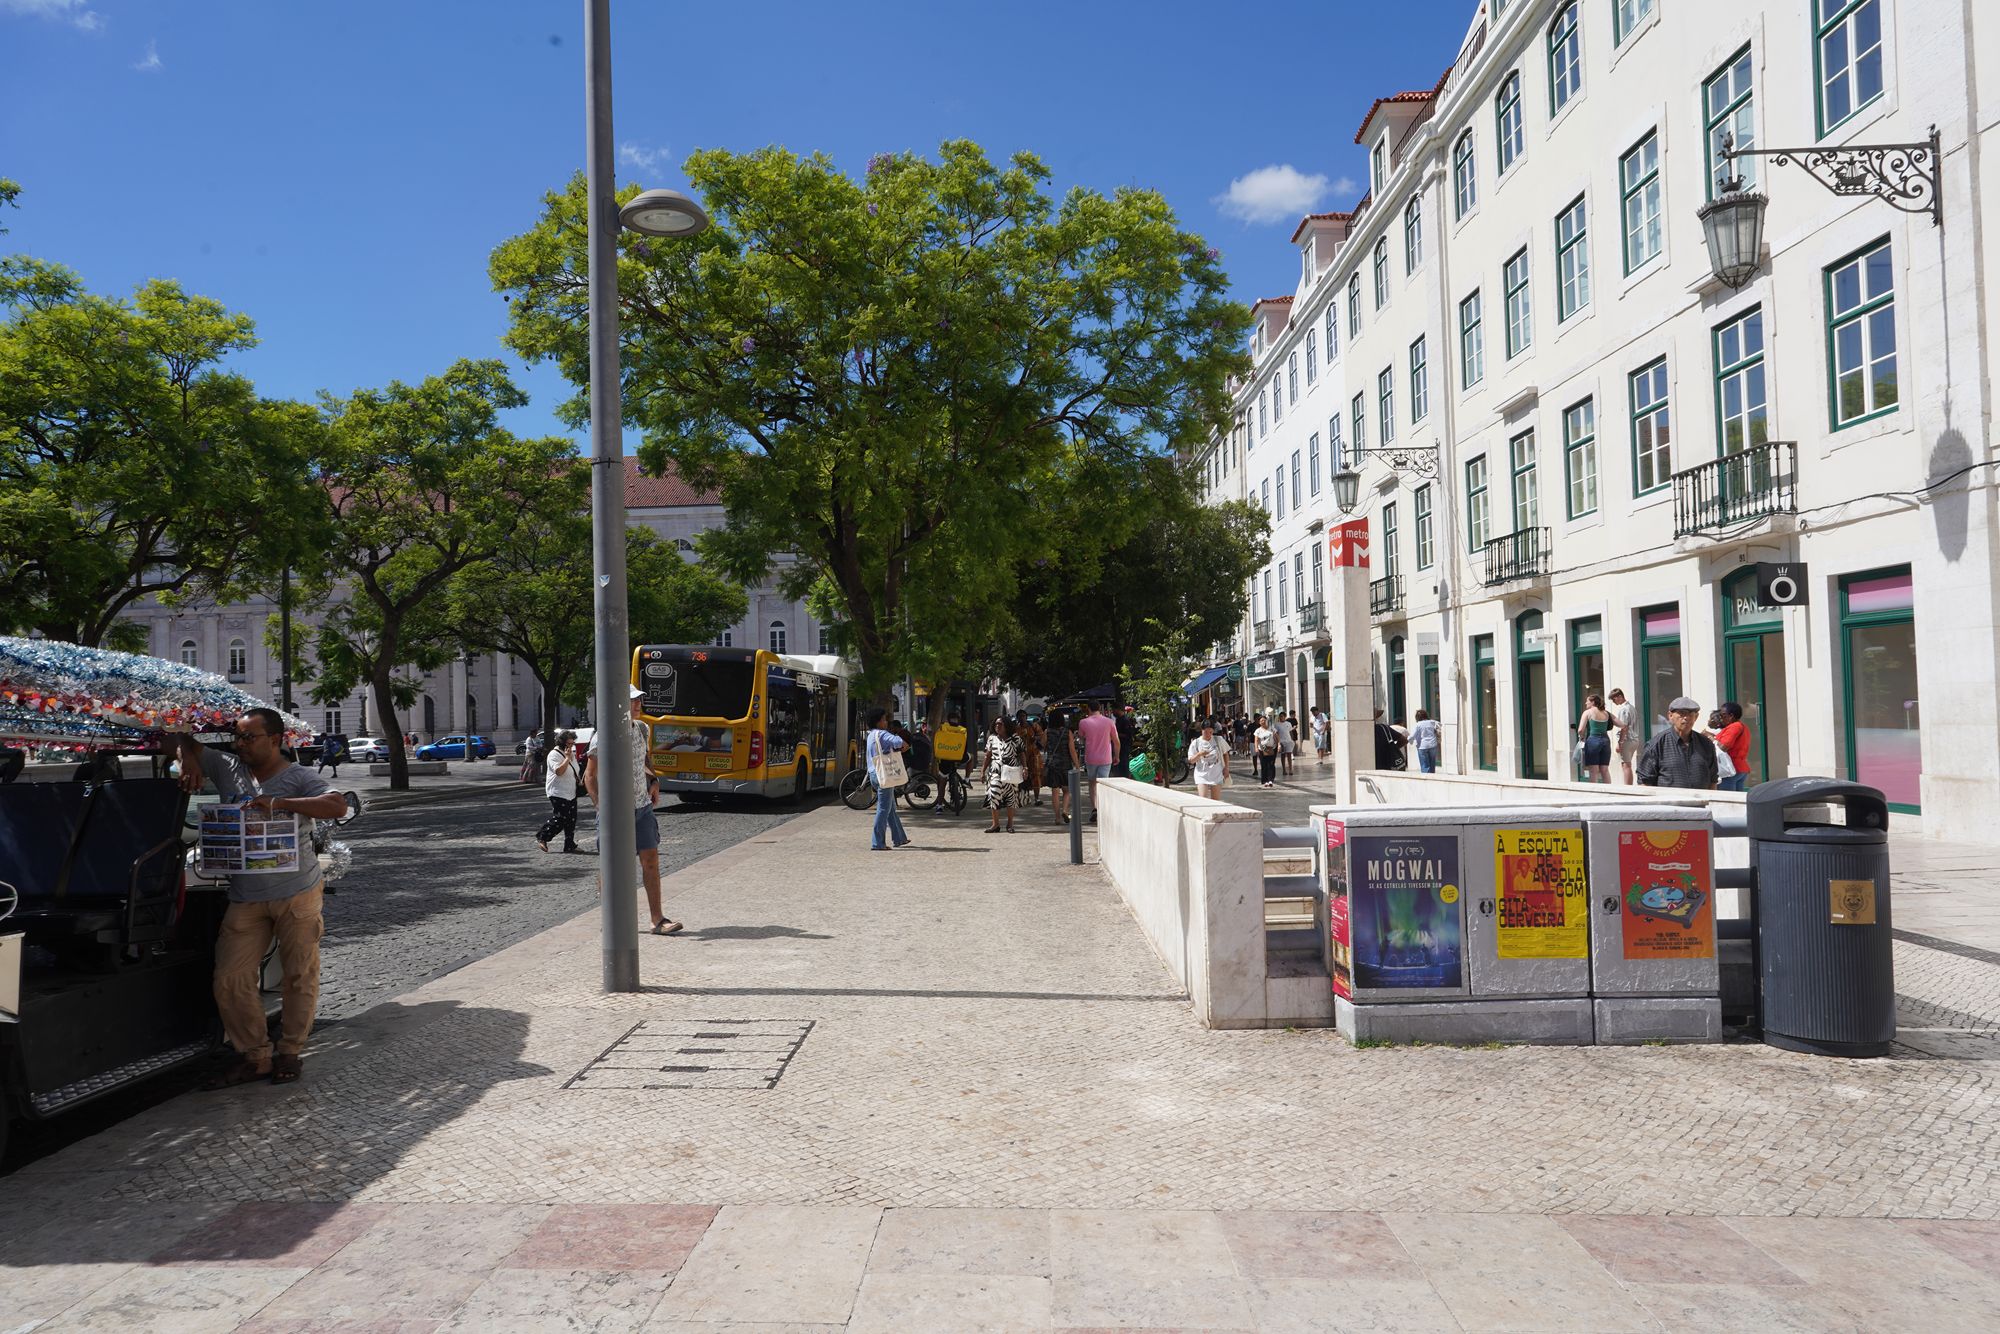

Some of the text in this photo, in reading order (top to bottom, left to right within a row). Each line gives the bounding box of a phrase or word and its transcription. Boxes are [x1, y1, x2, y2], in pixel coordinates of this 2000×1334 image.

[1345, 529, 1369, 540] metro
[937, 742, 959, 751] Glovo
[1497, 835, 1569, 853] À ESCUTA
[1536, 853, 1553, 868] DE
[1367, 859, 1442, 881] MOGWAI
[1532, 867, 1583, 883] ANGOLA
[1555, 882, 1584, 898] COM
[1498, 898, 1528, 913] GITA
[1499, 912, 1565, 928] CERVEIRA
